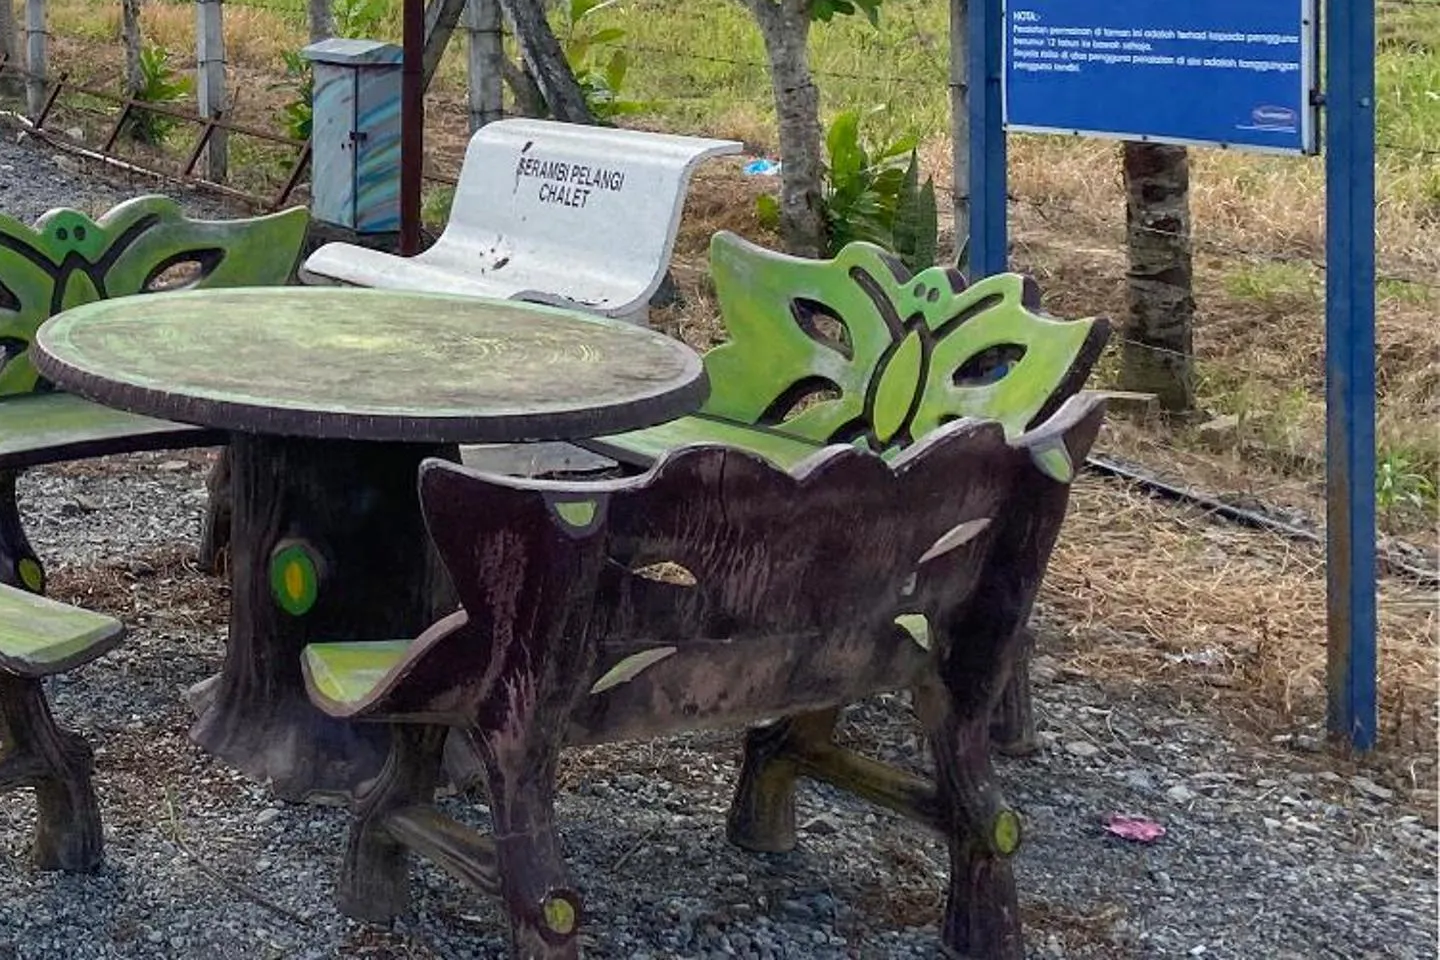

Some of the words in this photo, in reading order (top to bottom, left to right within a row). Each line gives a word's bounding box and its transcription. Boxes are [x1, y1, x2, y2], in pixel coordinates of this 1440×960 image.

[518, 157, 569, 182] SERAMBI
[570, 165, 625, 192] PELANGI
[539, 183, 591, 208] CHALET
